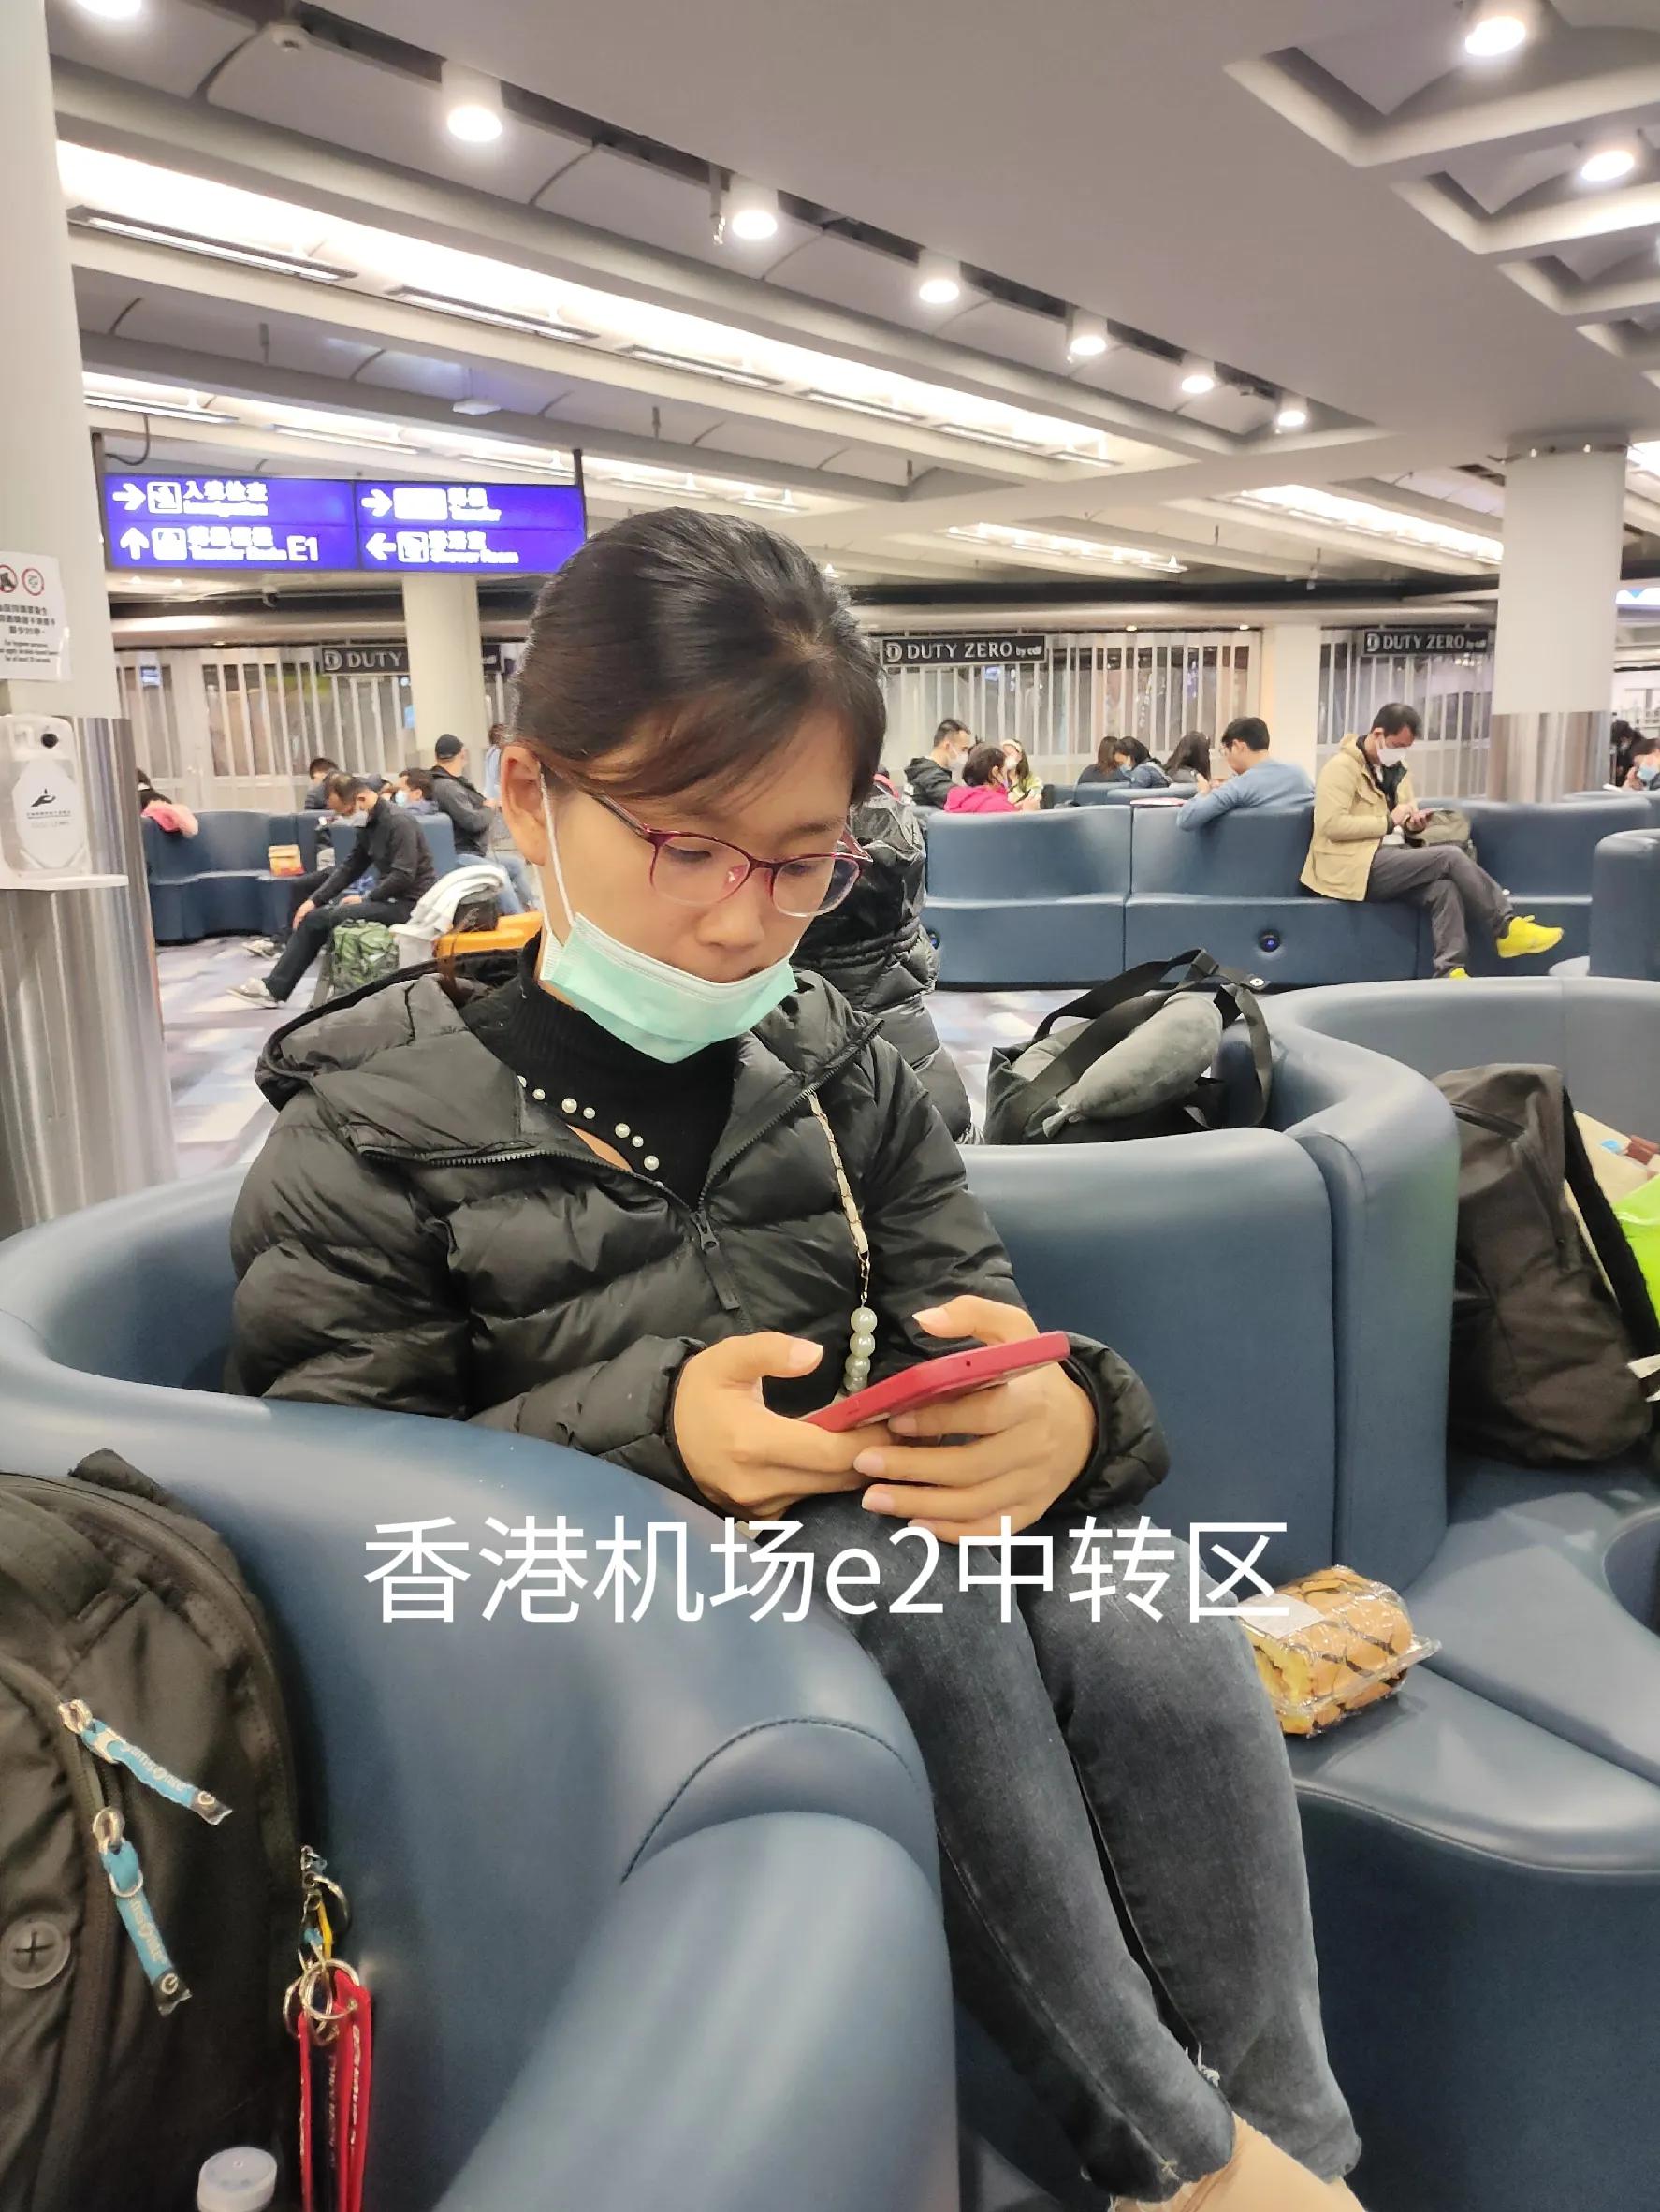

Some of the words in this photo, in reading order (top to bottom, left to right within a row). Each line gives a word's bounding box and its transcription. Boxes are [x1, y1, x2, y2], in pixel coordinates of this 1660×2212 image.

[286, 535, 318, 561] E1
[907, 643, 957, 659] DUTY
[964, 641, 1012, 659] ZERO
[1382, 634, 1422, 649] DUTY
[1425, 633, 1465, 649] ZERO
[347, 650, 402, 668] DUTY
